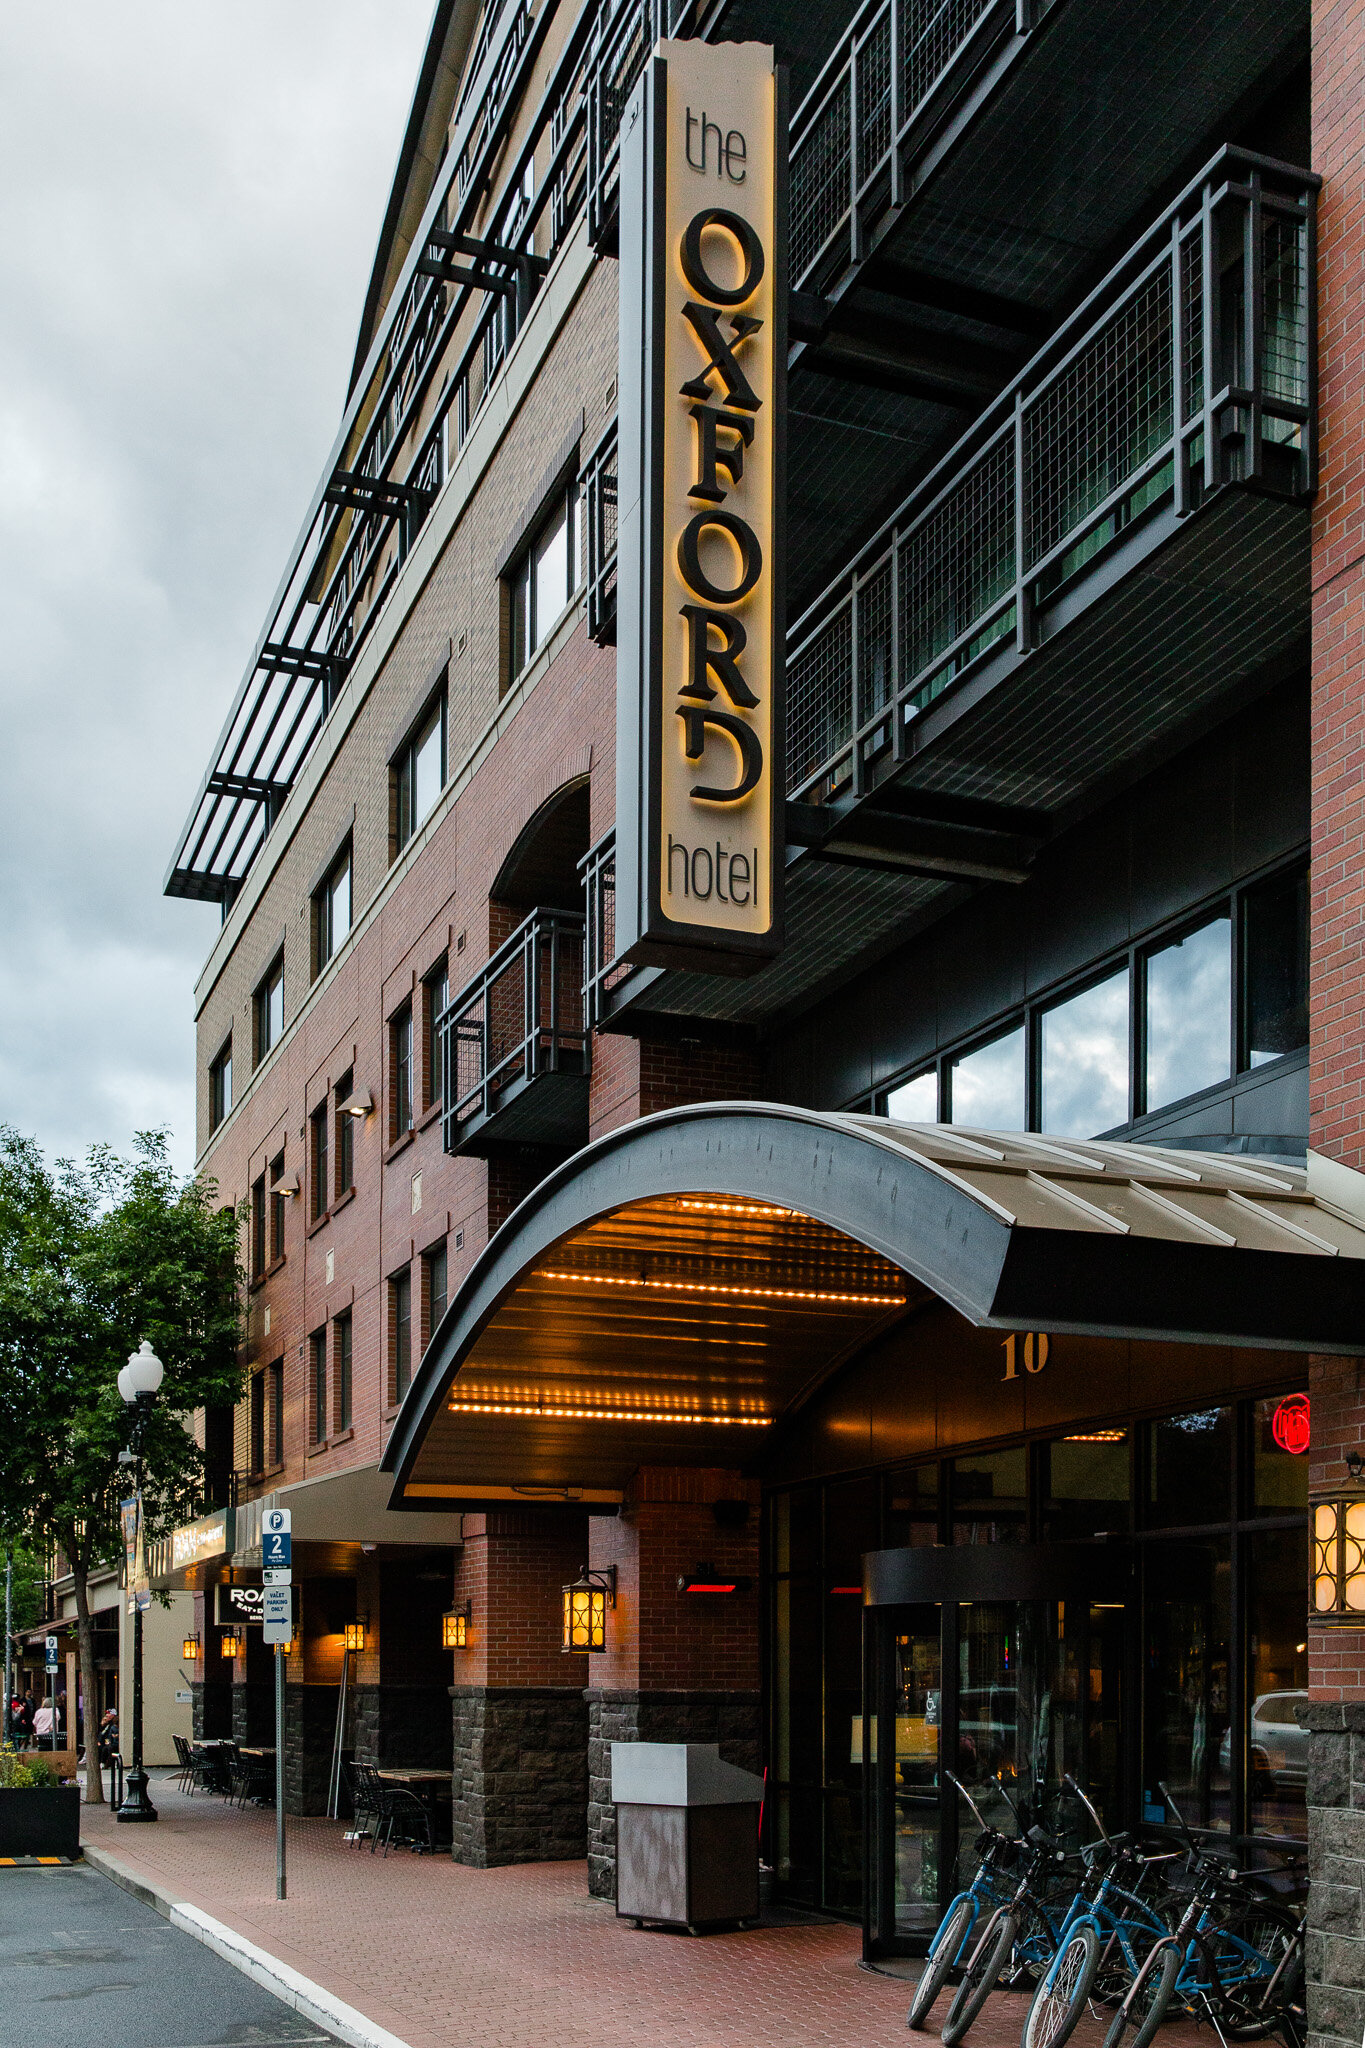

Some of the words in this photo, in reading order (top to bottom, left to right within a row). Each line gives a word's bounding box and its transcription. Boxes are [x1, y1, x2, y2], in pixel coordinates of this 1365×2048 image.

[685, 106, 747, 184] the
[676, 208, 765, 803] OXFORD
[668, 833, 758, 907] hotel
[1001, 1332, 1049, 1382] 10
[271, 1534, 282, 1554] 2
[236, 1602, 253, 1612] EAT
[49, 1649, 55, 1659] 2
